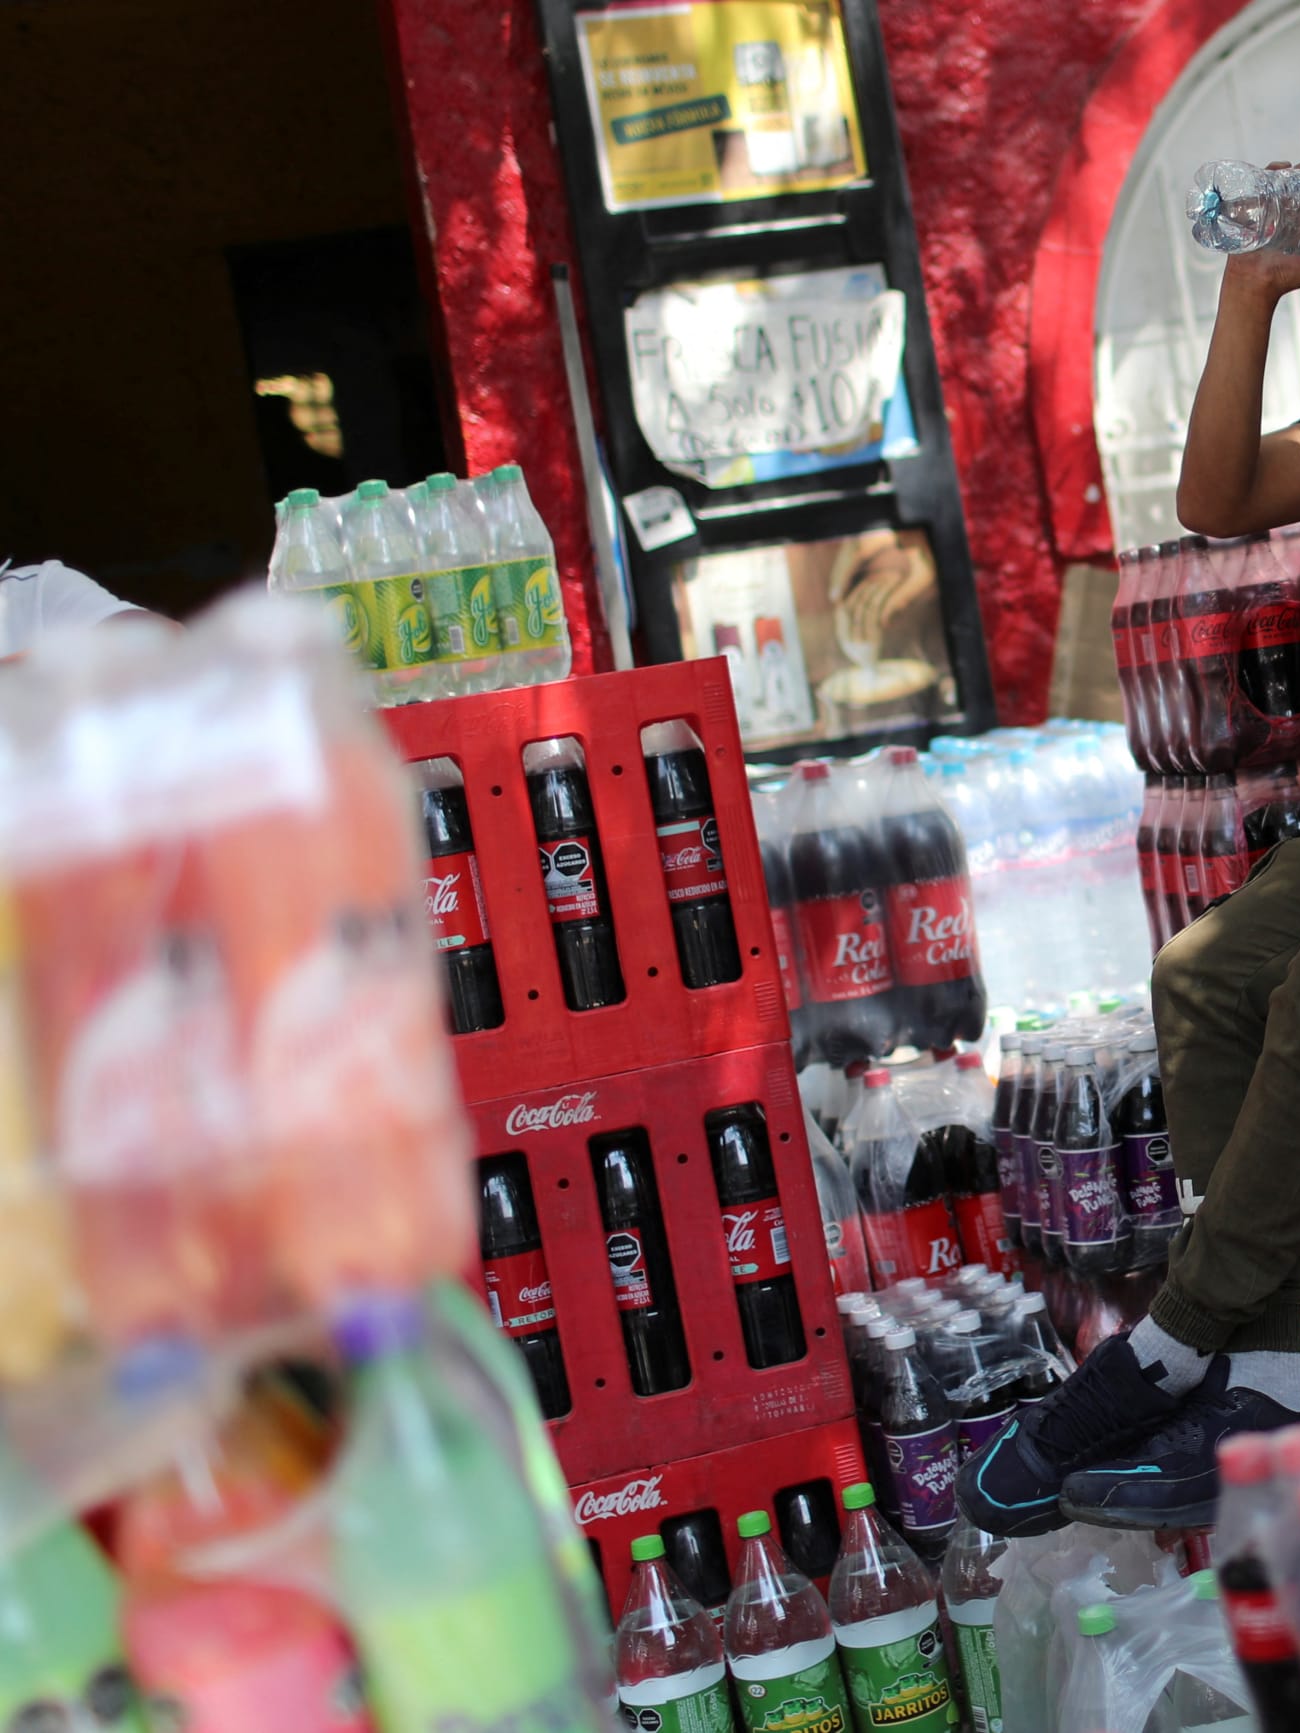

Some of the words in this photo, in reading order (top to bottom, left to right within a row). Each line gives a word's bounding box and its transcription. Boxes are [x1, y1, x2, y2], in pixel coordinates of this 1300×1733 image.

[907, 896, 970, 944] Red
[926, 941, 973, 966] Cola
[506, 1091, 596, 1135] Coca-Cola
[575, 1473, 664, 1525] Coca-Cola
[875, 1686, 948, 1722] JARRITOS
